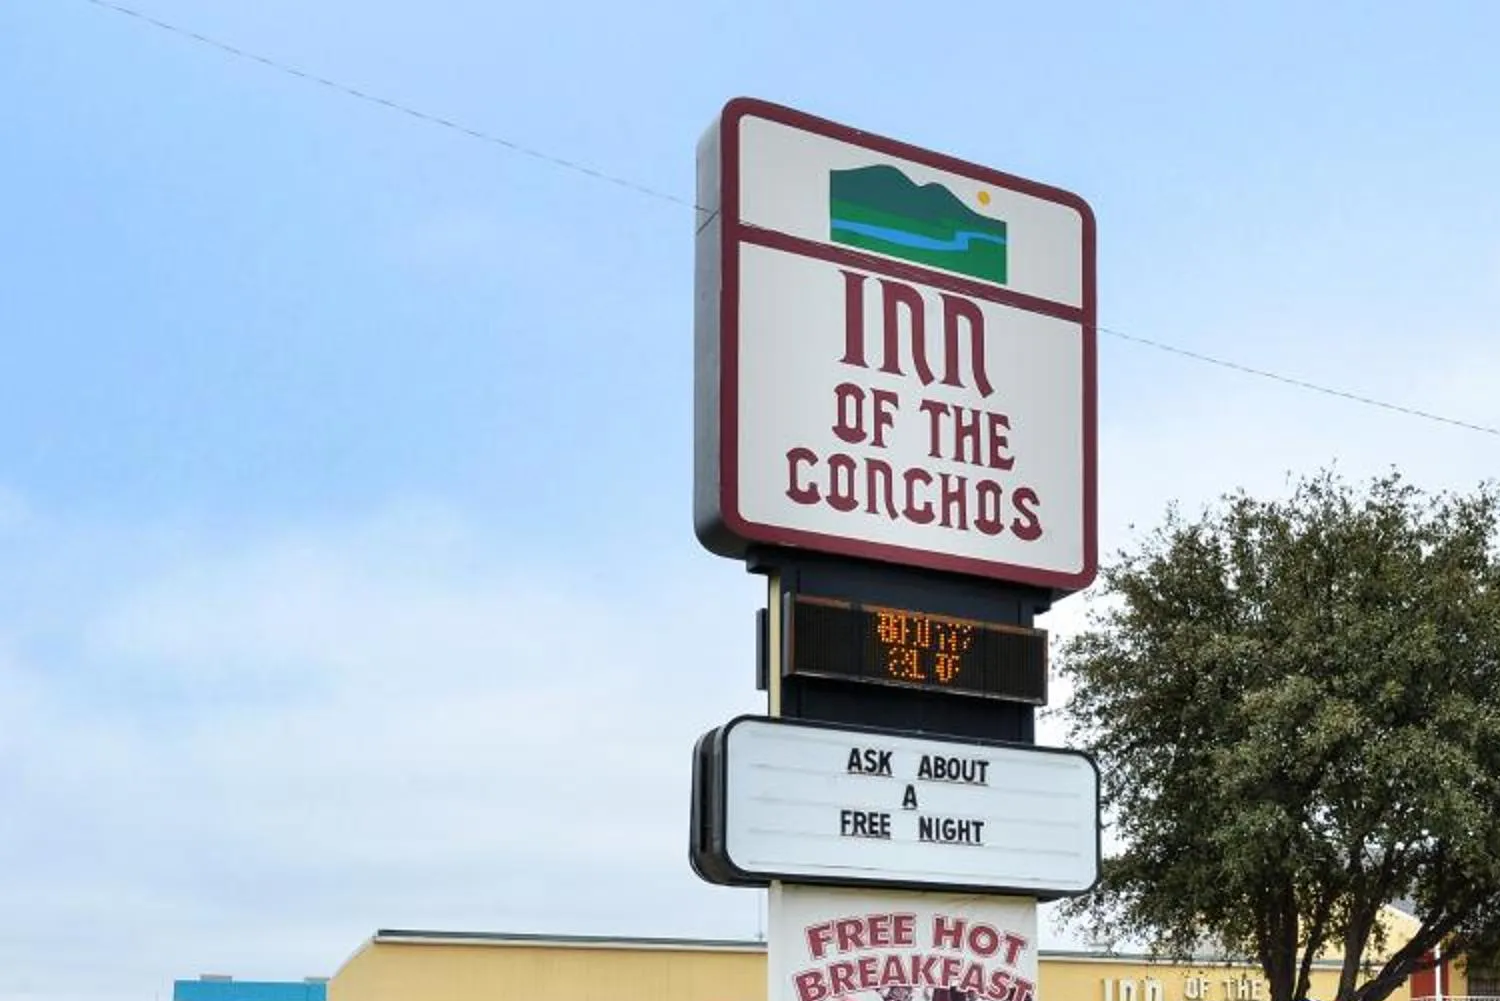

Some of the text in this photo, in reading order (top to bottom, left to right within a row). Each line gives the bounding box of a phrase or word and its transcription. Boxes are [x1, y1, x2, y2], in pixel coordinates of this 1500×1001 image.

[838, 270, 994, 398] INN
[832, 382, 1015, 471] OF THE
[785, 447, 1043, 541] CONCHOS
[847, 748, 989, 784] ASK ABOUT
[902, 785, 917, 809] A
[841, 810, 984, 844] FREE NIGHT
[805, 912, 1028, 967] FREE HOT
[1184, 976, 1209, 1000] OF
[1223, 978, 1262, 1001] THE
